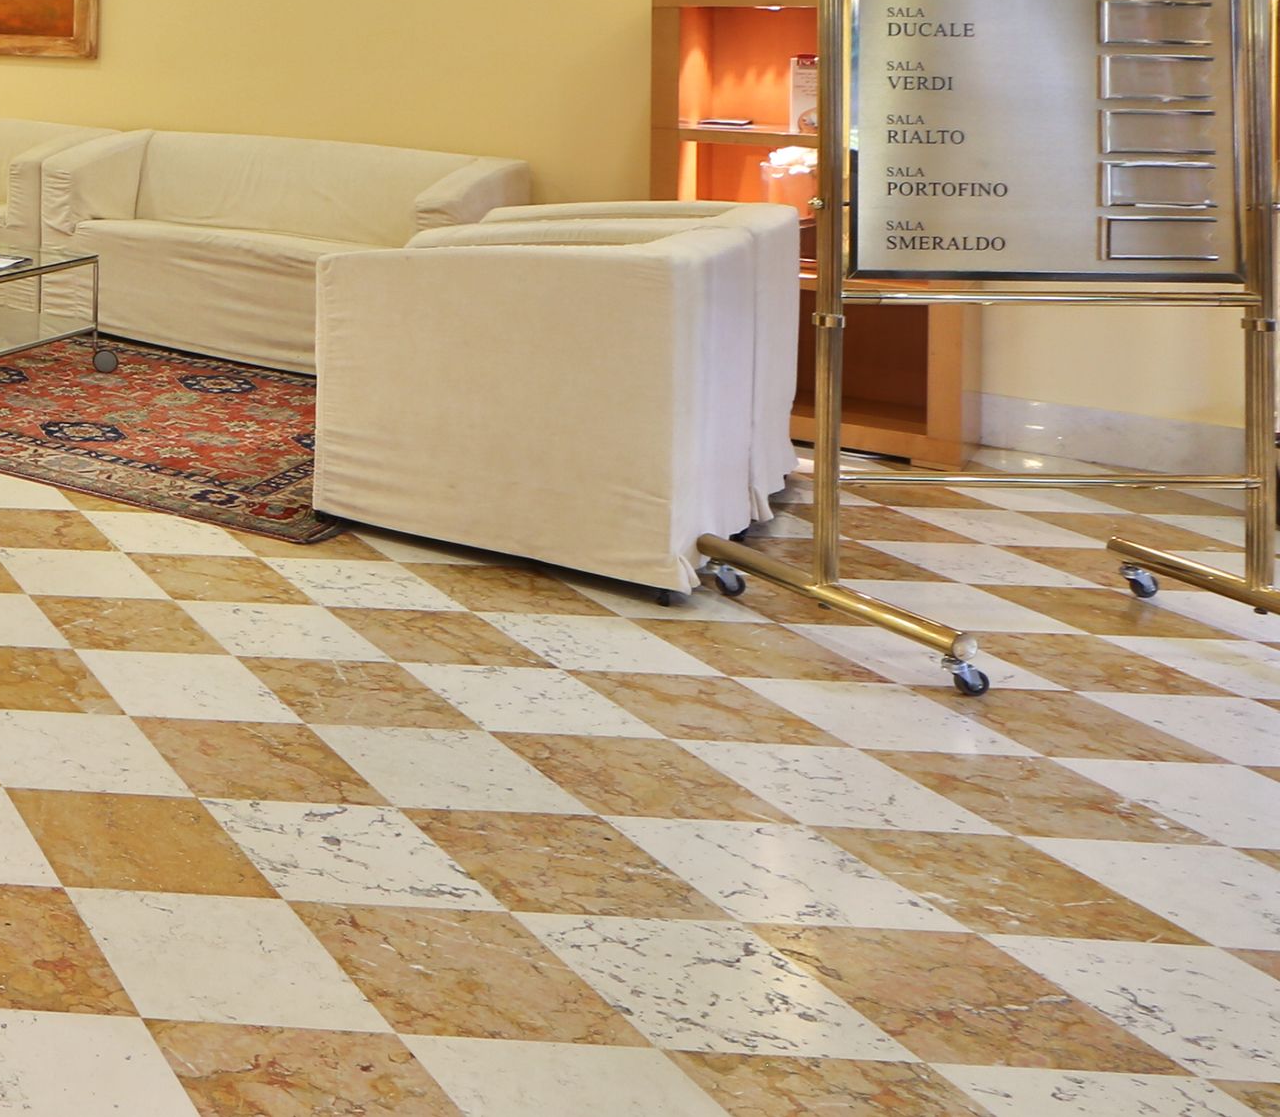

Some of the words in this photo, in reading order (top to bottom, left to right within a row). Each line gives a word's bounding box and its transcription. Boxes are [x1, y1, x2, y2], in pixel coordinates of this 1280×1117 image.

[887, 7, 924, 18] SALA
[887, 23, 975, 37] DUCALE
[887, 61, 924, 71] SALA
[887, 76, 953, 91] VERDI
[887, 114, 924, 125] SALA
[887, 129, 965, 144] RIALTO
[887, 167, 924, 177] SALA
[887, 182, 1008, 197] PORTOFINO
[886, 220, 924, 231] SALA
[886, 235, 1006, 251] SMERALDO
